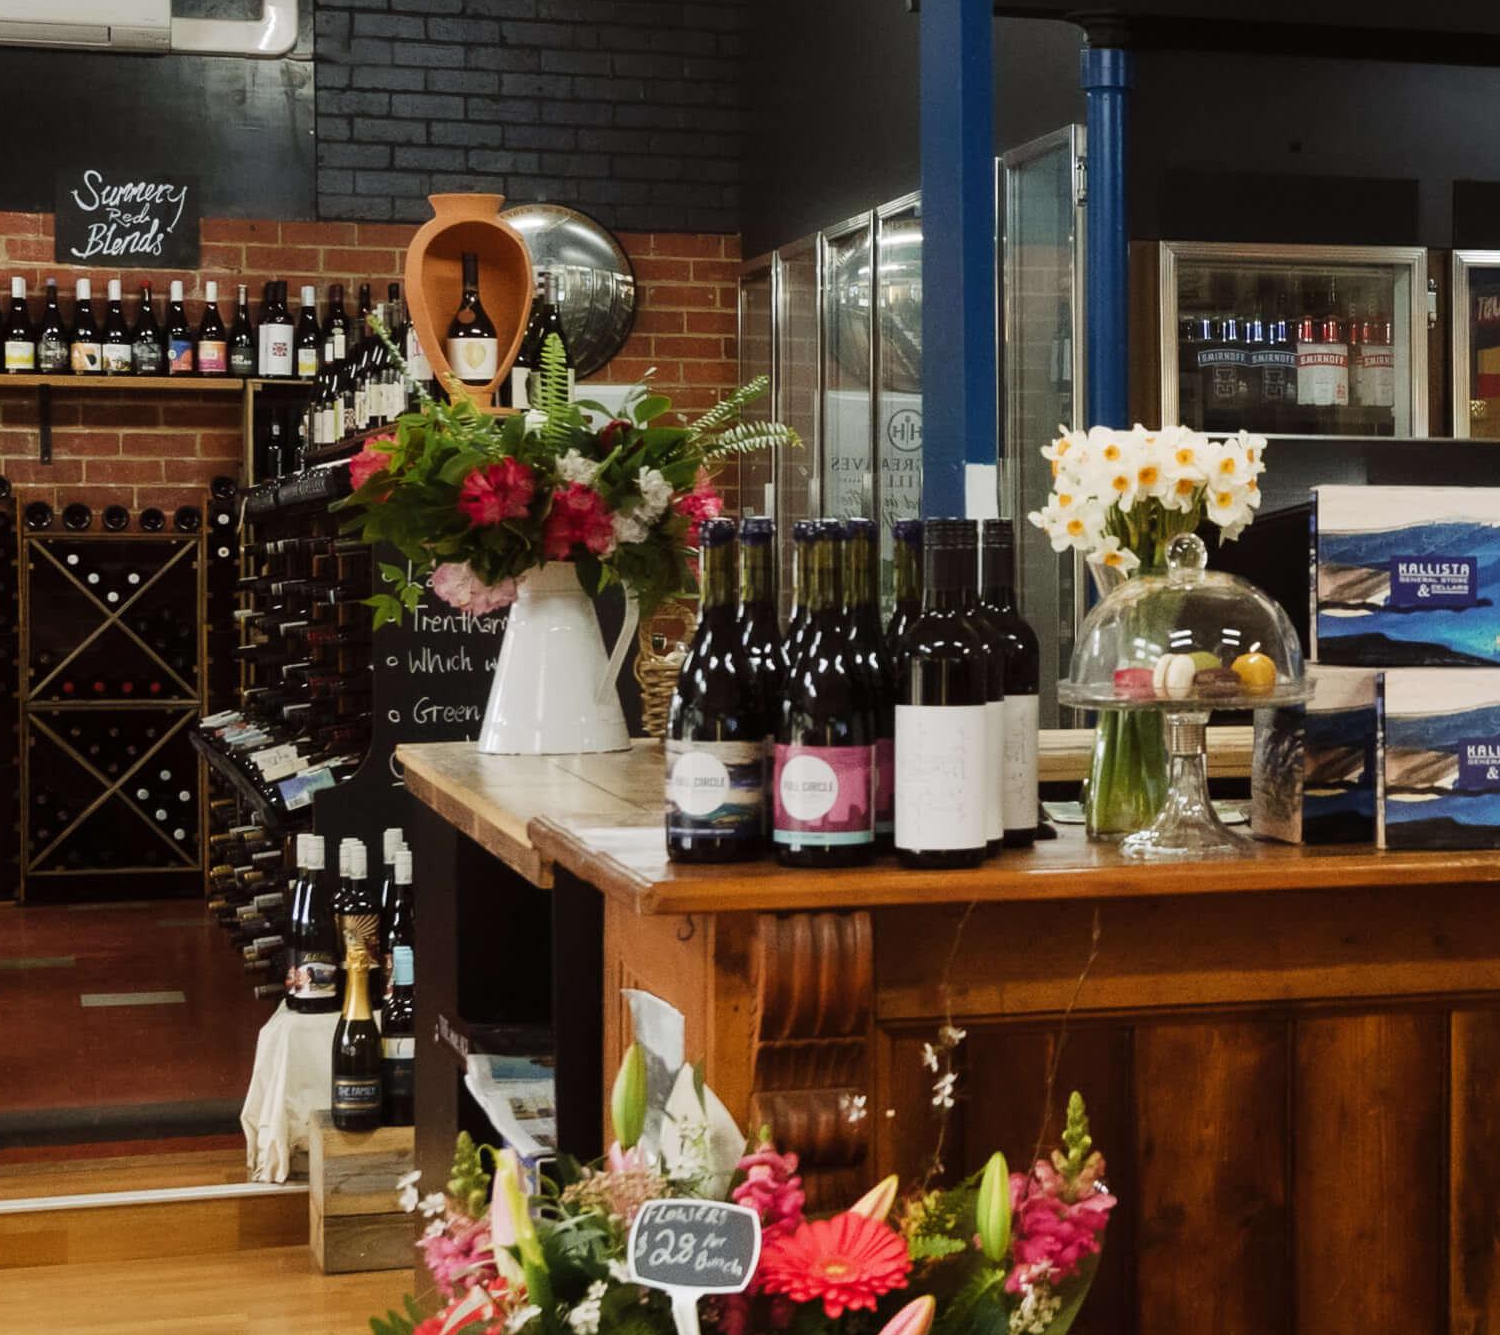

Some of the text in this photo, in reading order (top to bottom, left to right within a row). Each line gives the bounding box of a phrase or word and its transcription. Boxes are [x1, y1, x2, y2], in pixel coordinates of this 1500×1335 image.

[70, 218, 164, 259] Blends
[1202, 352, 1245, 363] SMIRNOFF
[1300, 355, 1345, 364] SMIRNOFF
[1398, 563, 1470, 577] KALLISTA
[1417, 583, 1469, 598] & CELLARS
[408, 646, 473, 674] Which
[413, 697, 481, 724] Green
[1486, 765, 1500, 780] &
